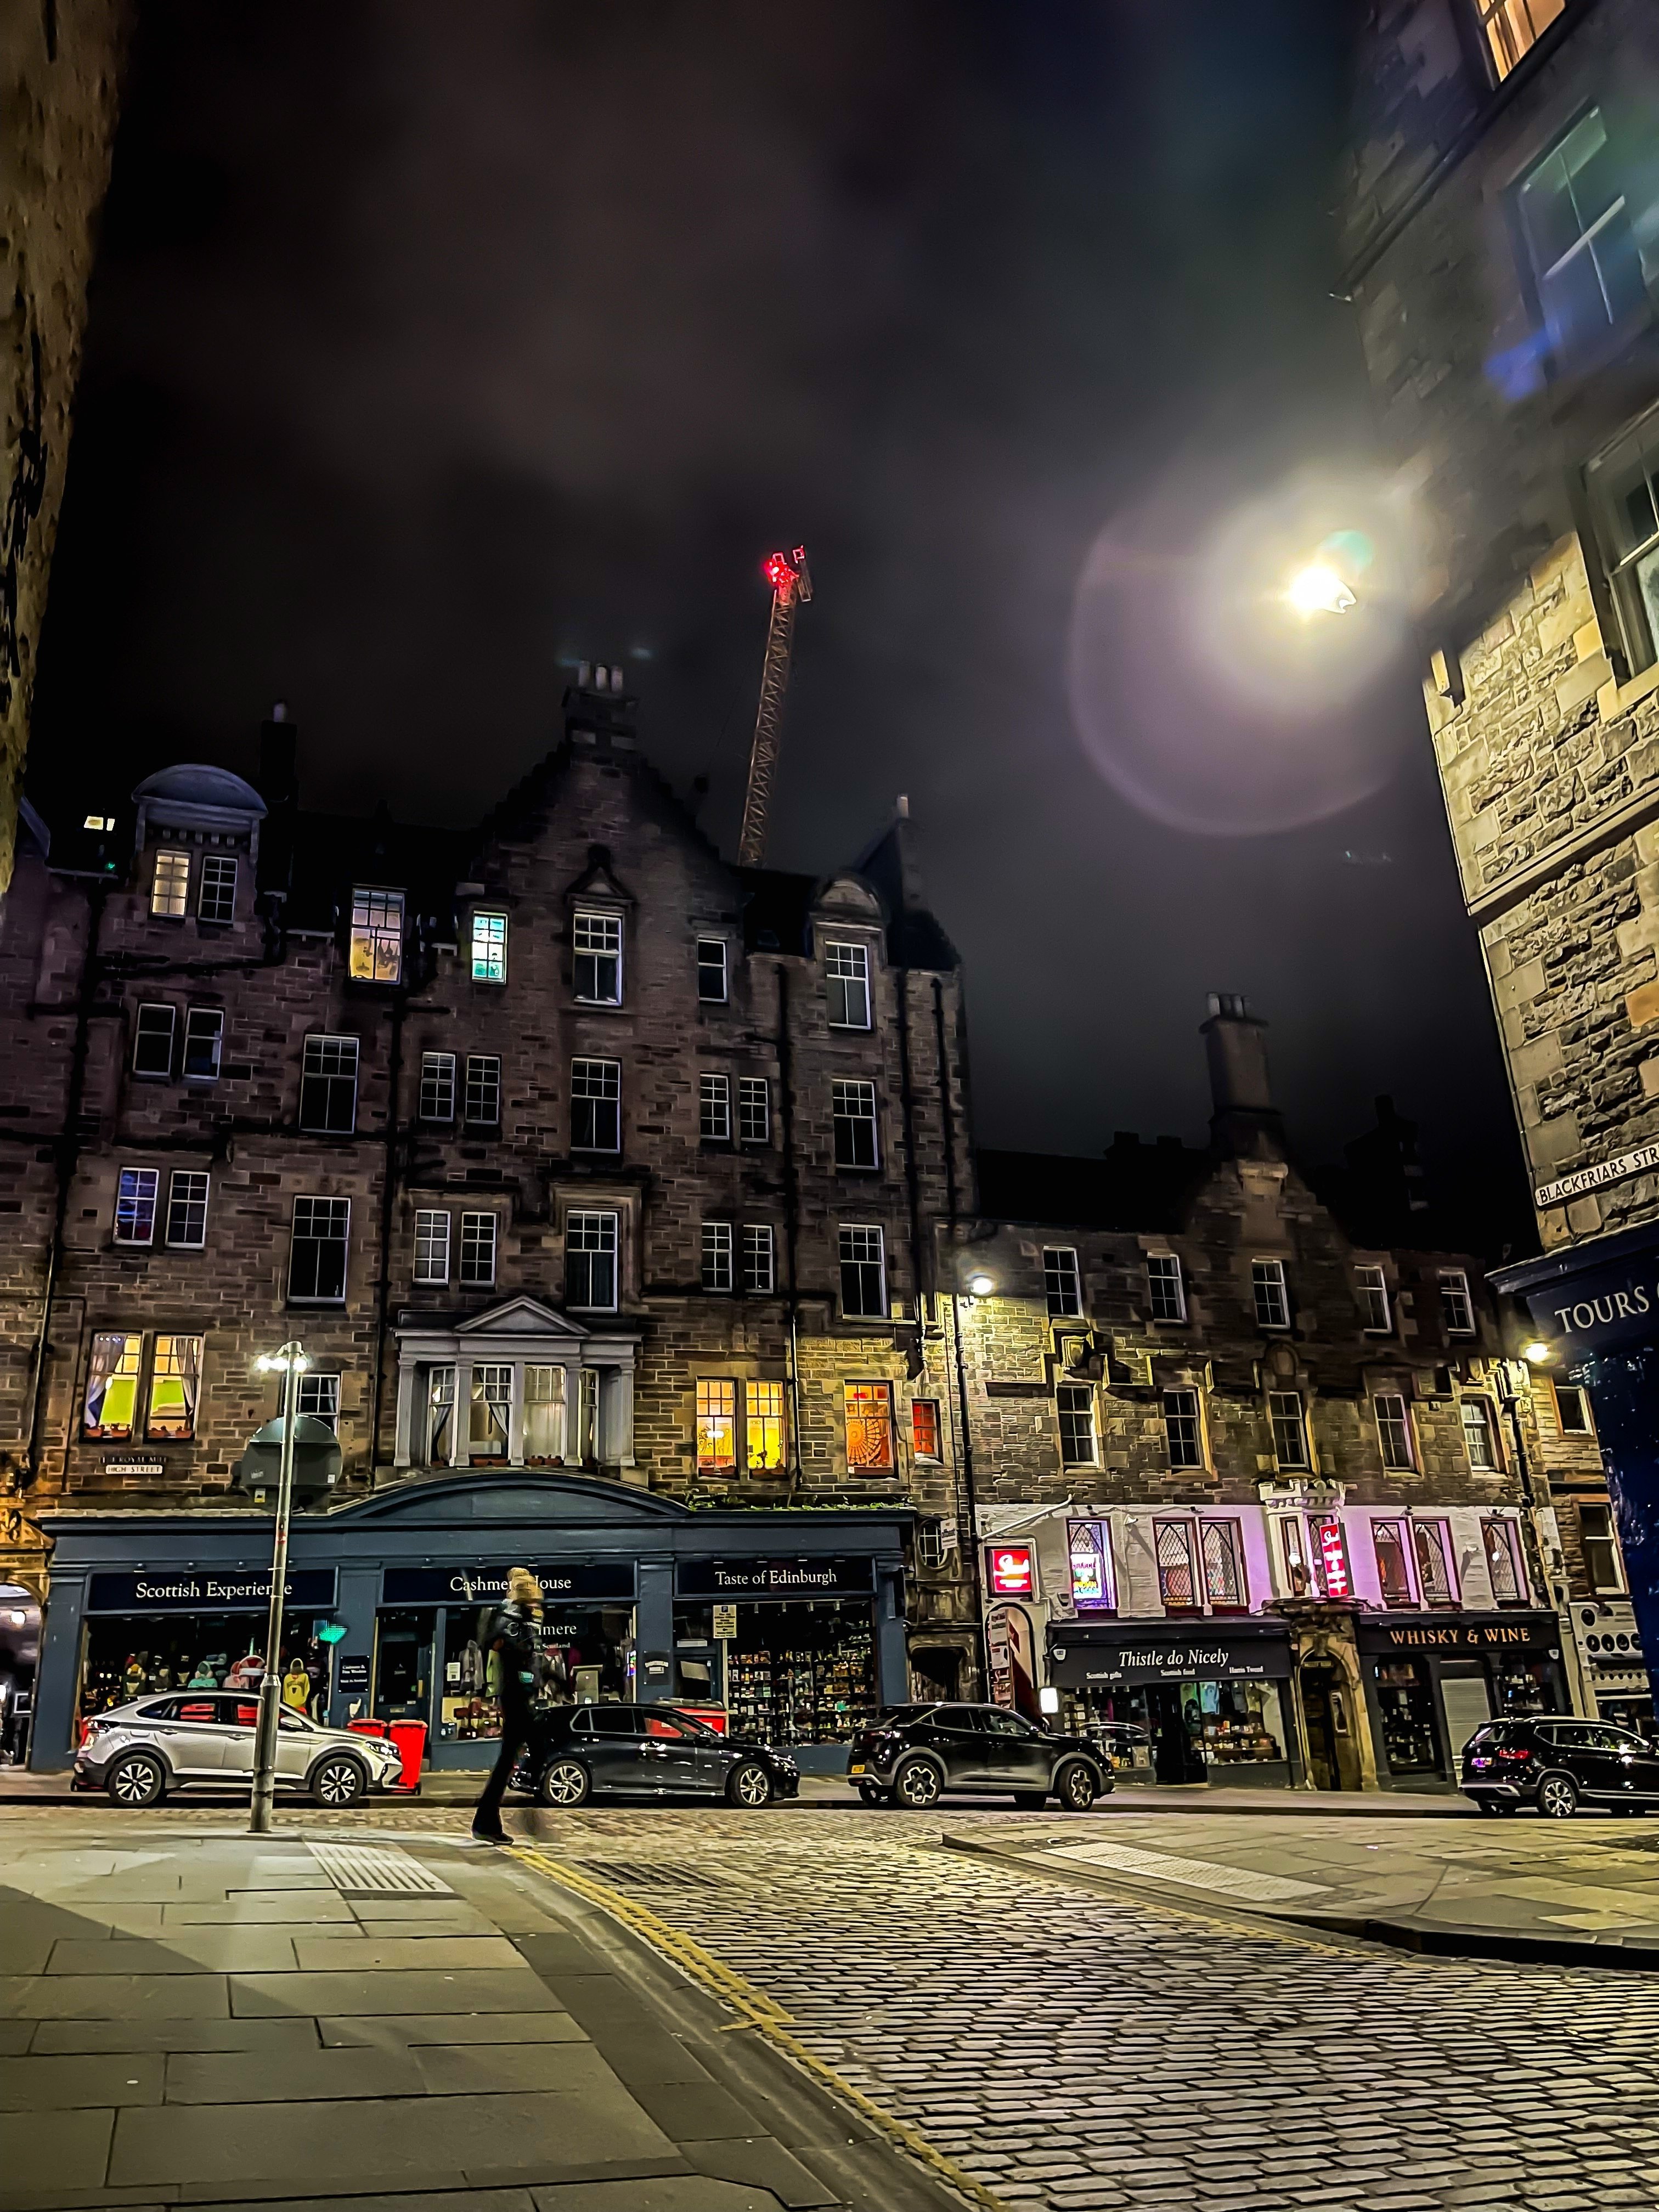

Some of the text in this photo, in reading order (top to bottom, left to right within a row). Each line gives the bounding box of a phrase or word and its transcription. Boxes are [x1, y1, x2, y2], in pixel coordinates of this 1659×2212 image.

[1539, 1144, 1659, 1204] BLACKFRIARS STR
[1554, 1286, 1650, 1333] TOURS
[450, 1576, 513, 1591] Cashmer
[715, 1568, 838, 1585] Taste of Edinburgh
[136, 1581, 292, 1600] Scottish Experiene
[1390, 1628, 1530, 1645] WHISKY & WINE
[1119, 1648, 1229, 1667] Thistle do Nicely
